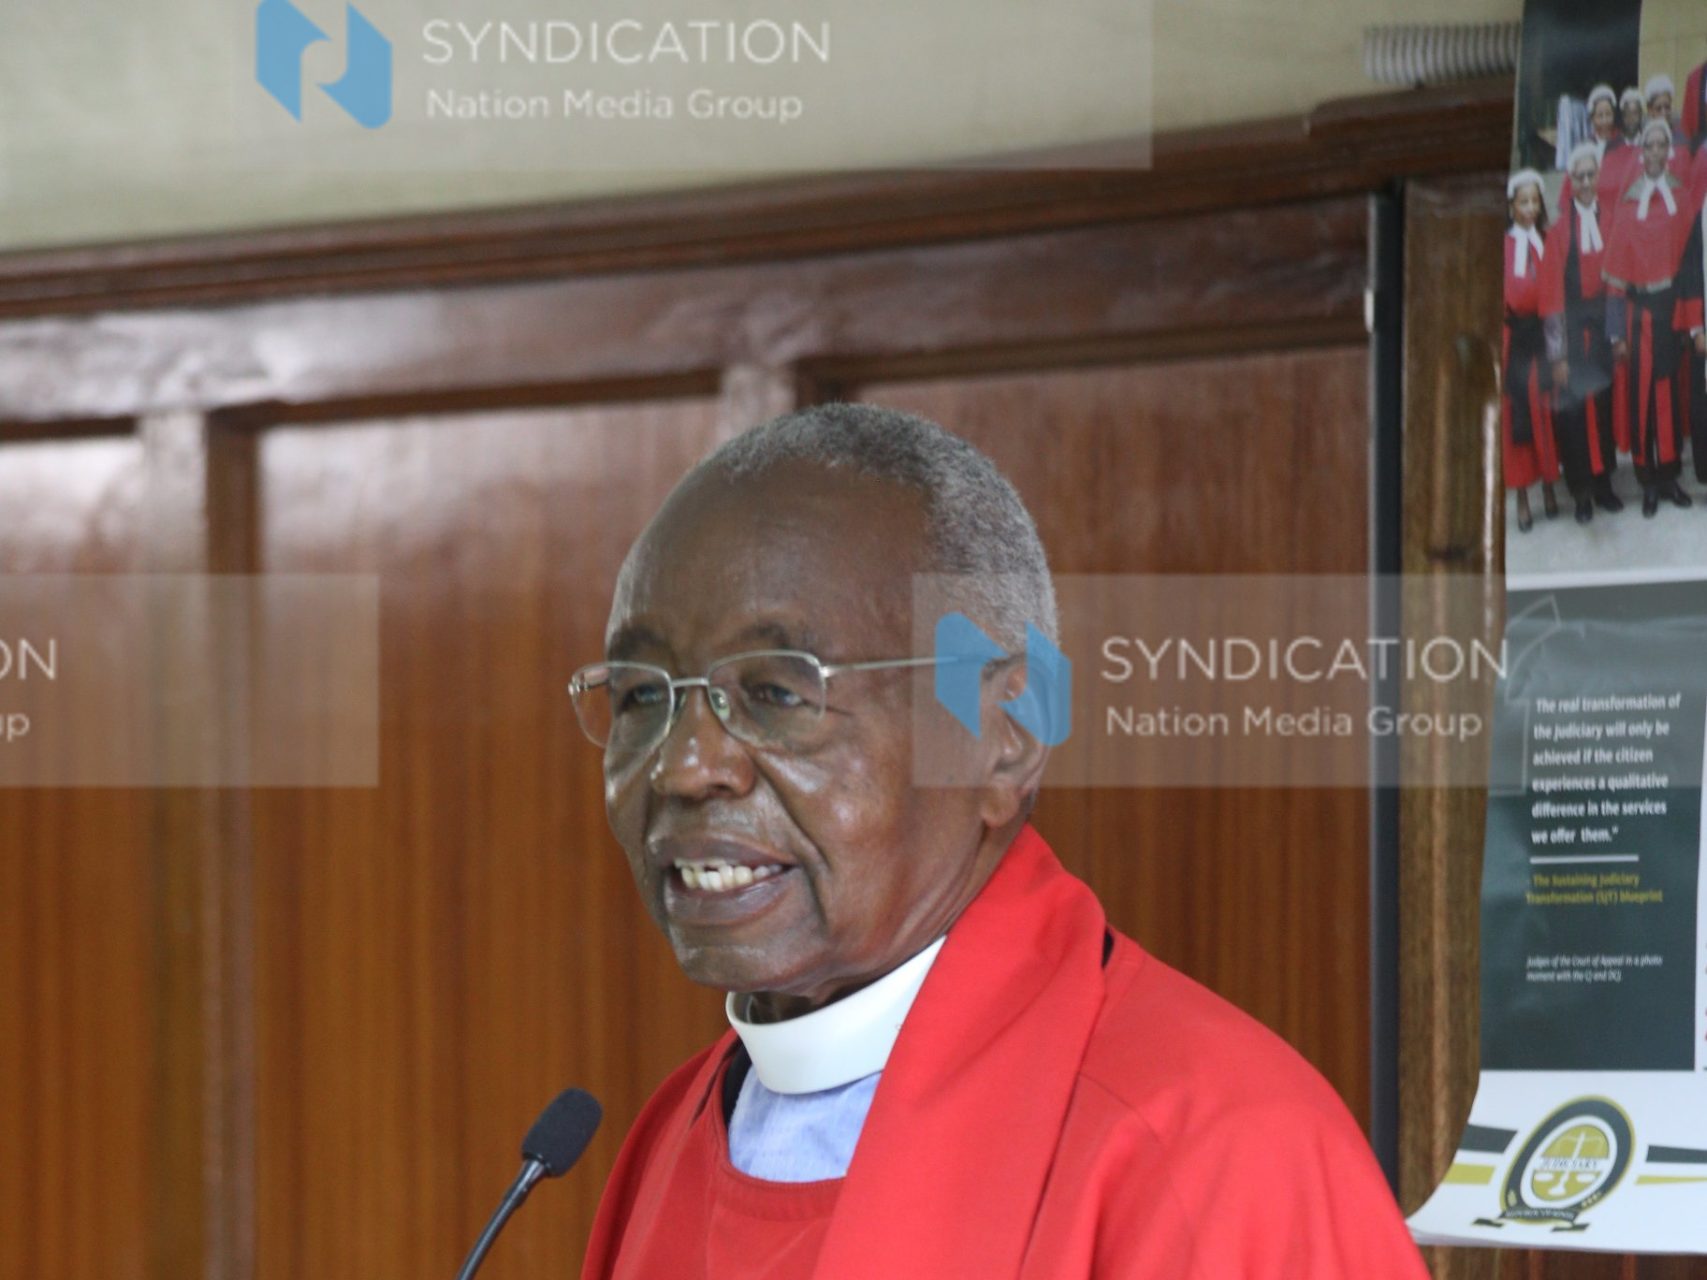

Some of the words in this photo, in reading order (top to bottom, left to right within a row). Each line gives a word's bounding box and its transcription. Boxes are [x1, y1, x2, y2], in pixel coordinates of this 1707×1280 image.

[1536, 697, 1556, 713] The
[1558, 696, 1580, 713] real
[1582, 694, 1666, 712] transformation
[1668, 692, 1682, 709] of
[1533, 722, 1551, 740] the
[1605, 721, 1627, 738] will
[1628, 720, 1654, 739] only
[1655, 718, 1670, 736] be
[1533, 749, 1581, 766] achieved
[1582, 748, 1593, 764] if
[1594, 747, 1613, 764] the
[1615, 746, 1654, 763] citizen
[1531, 774, 1597, 795] experiences
[1598, 776, 1606, 791] a
[1607, 773, 1669, 793] qualitative
[1531, 800, 1586, 818] difference
[1587, 799, 1599, 816] in
[1600, 799, 1620, 816] the
[1621, 798, 1668, 815] services
[1531, 830, 1548, 844] we
[1550, 828, 1576, 844] offer
